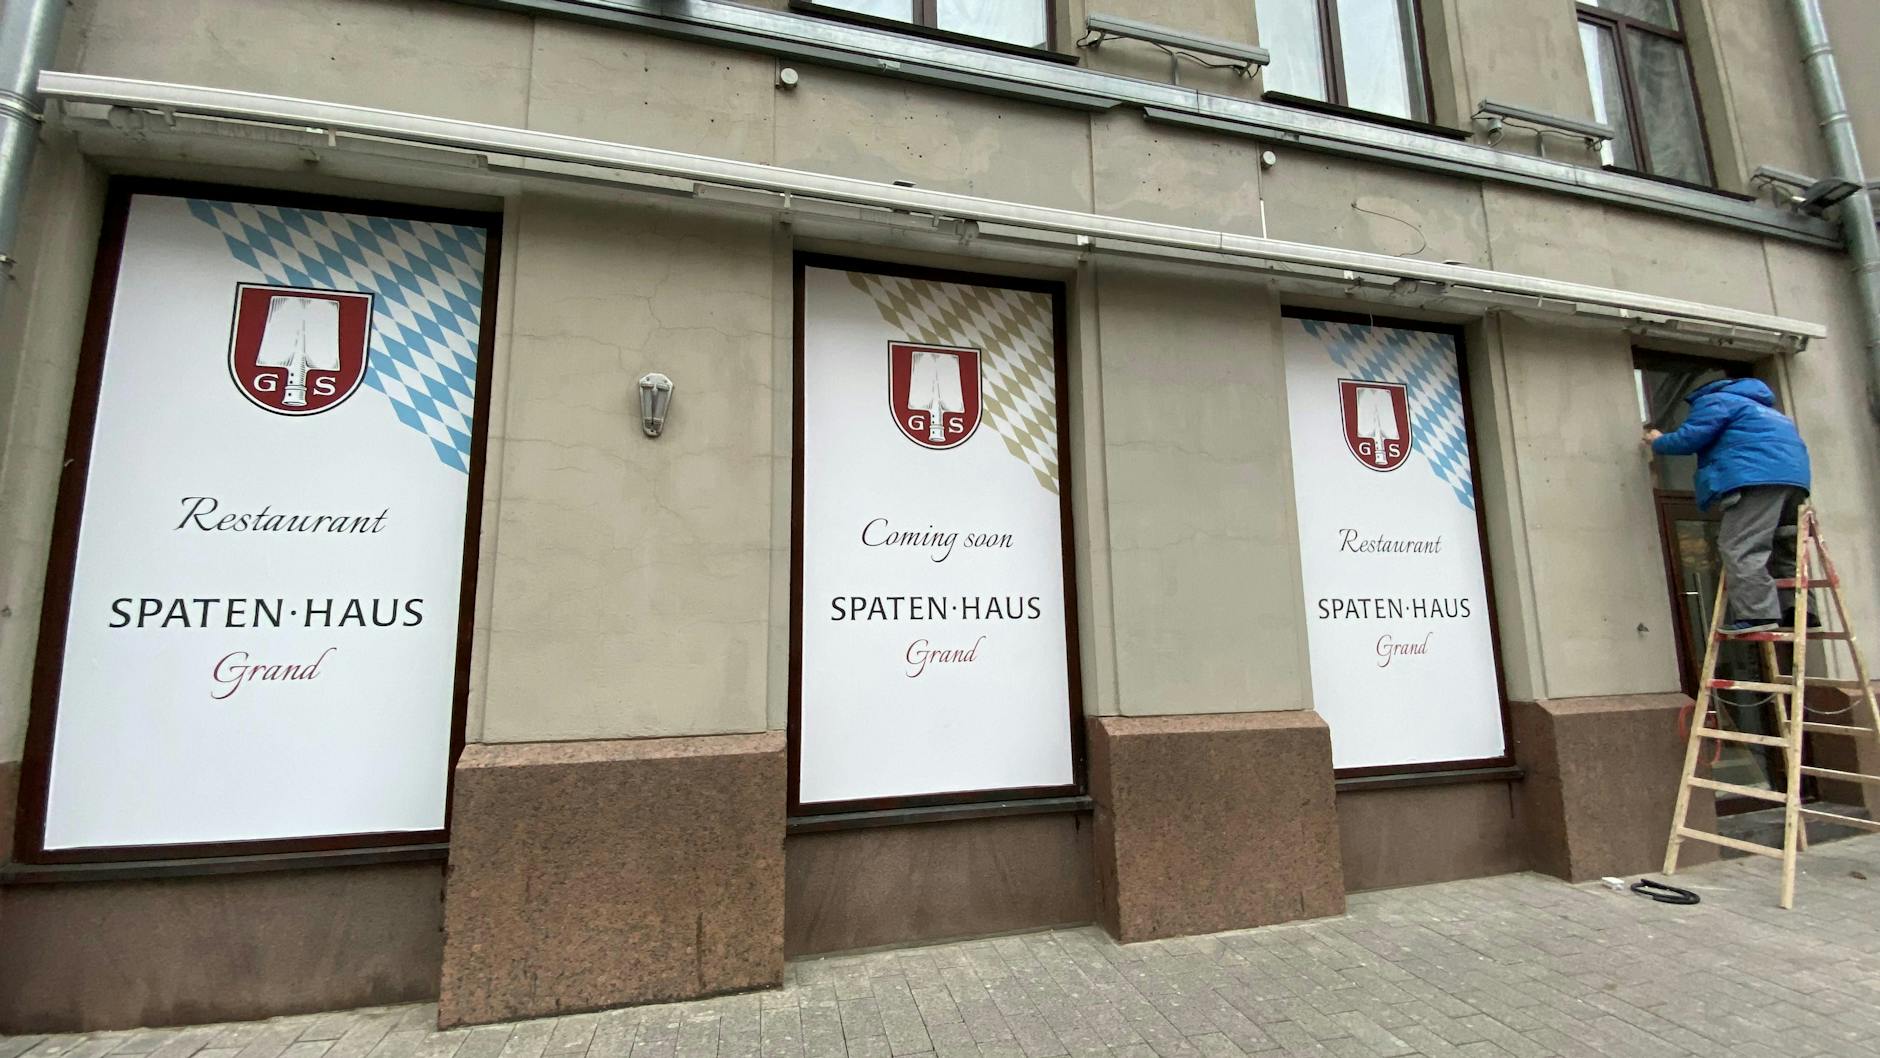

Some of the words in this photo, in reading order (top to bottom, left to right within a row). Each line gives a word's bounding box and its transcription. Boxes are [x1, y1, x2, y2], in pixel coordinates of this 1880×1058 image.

[254, 372, 278, 394] G
[312, 375, 336, 397] S
[908, 415, 925, 431] G
[948, 417, 964, 434] S
[1358, 442, 1372, 456] G
[1388, 443, 1401, 458] S
[173, 496, 390, 534] Restaurant
[861, 517, 960, 563] Coming
[963, 532, 1014, 549] soon
[1338, 528, 1442, 554] Restaurant
[905, 635, 987, 679] Grand
[1376, 631, 1434, 668] Grand
[210, 647, 337, 700] Grand
